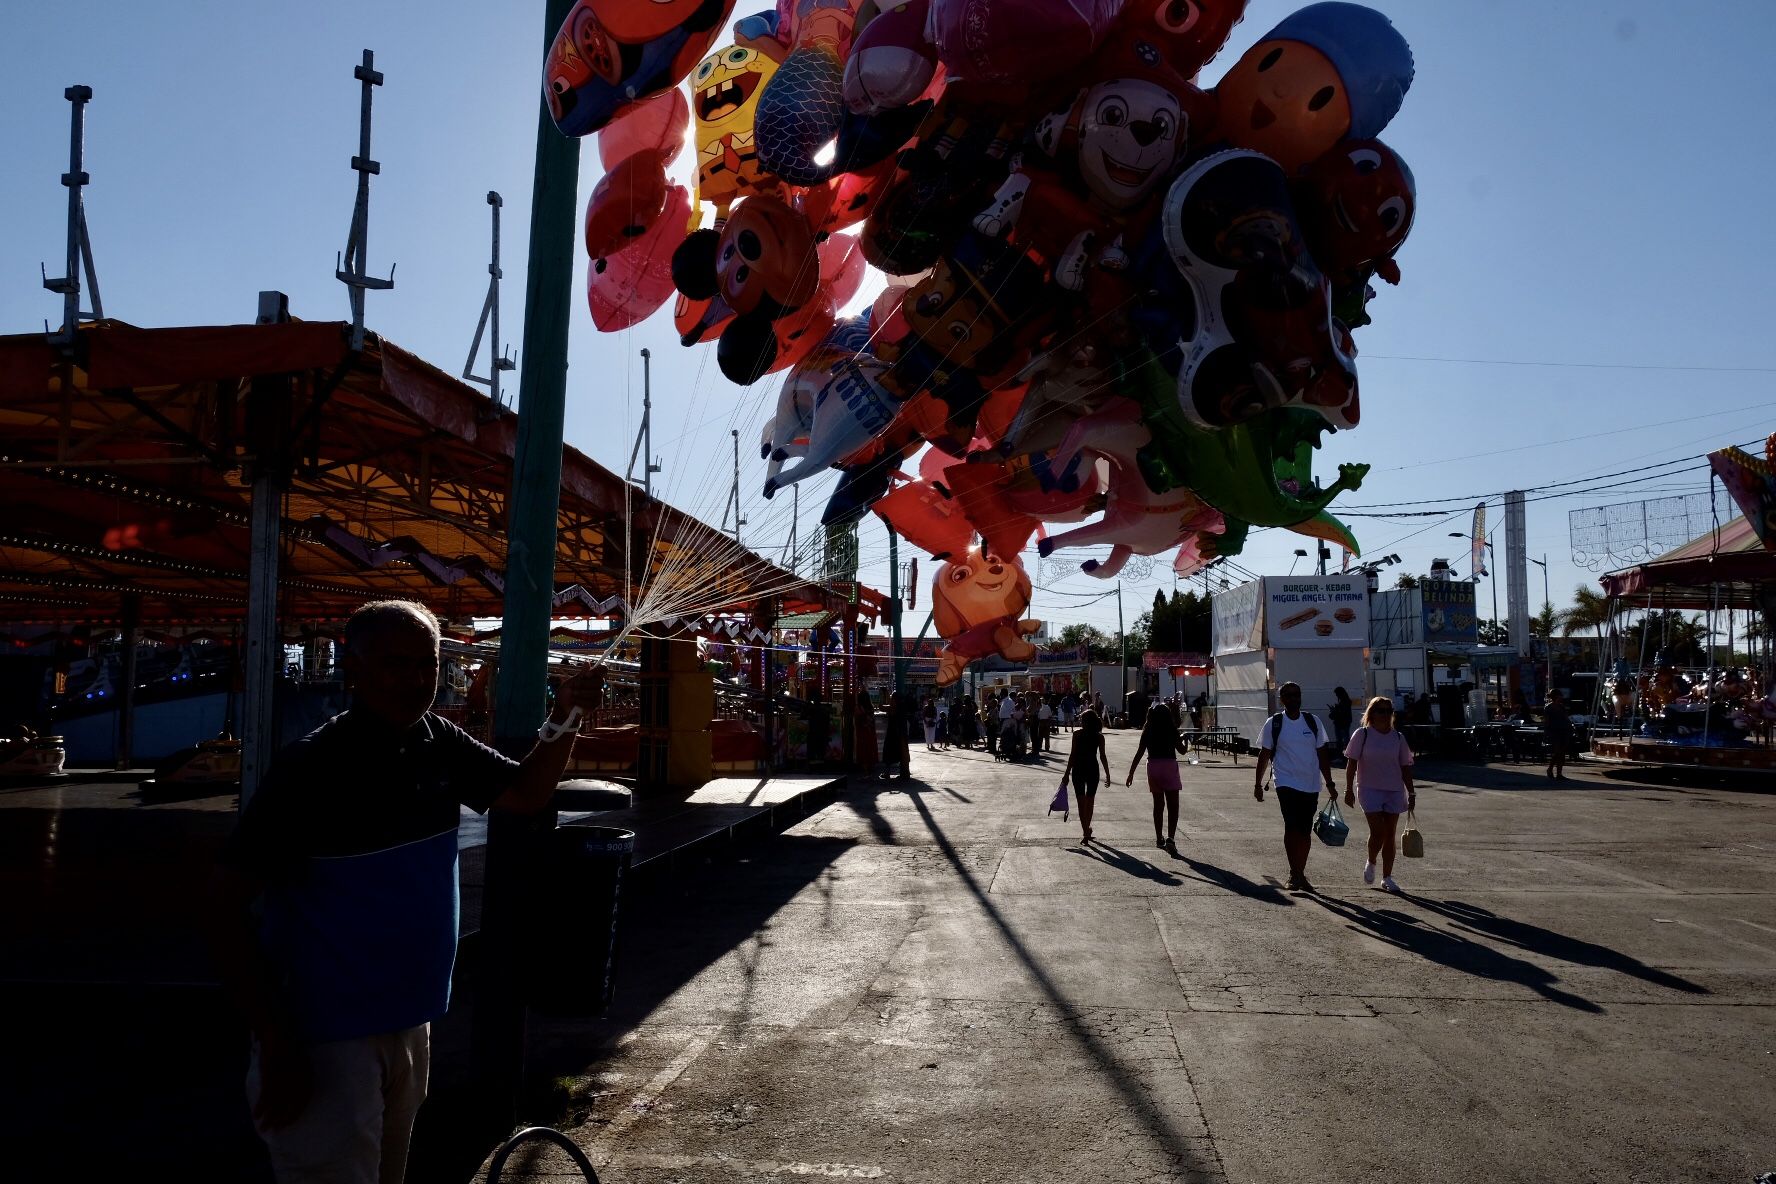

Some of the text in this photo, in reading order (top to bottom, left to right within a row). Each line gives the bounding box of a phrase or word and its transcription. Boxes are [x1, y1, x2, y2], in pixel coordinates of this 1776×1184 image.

[1283, 584, 1319, 593] BURGUER
[1326, 583, 1351, 592] KEBAB
[1272, 594, 1300, 603] MIGUEL
[1302, 593, 1326, 603] ANGEL
[1335, 592, 1363, 602] AITANA
[1423, 591, 1473, 603] BELINDA
